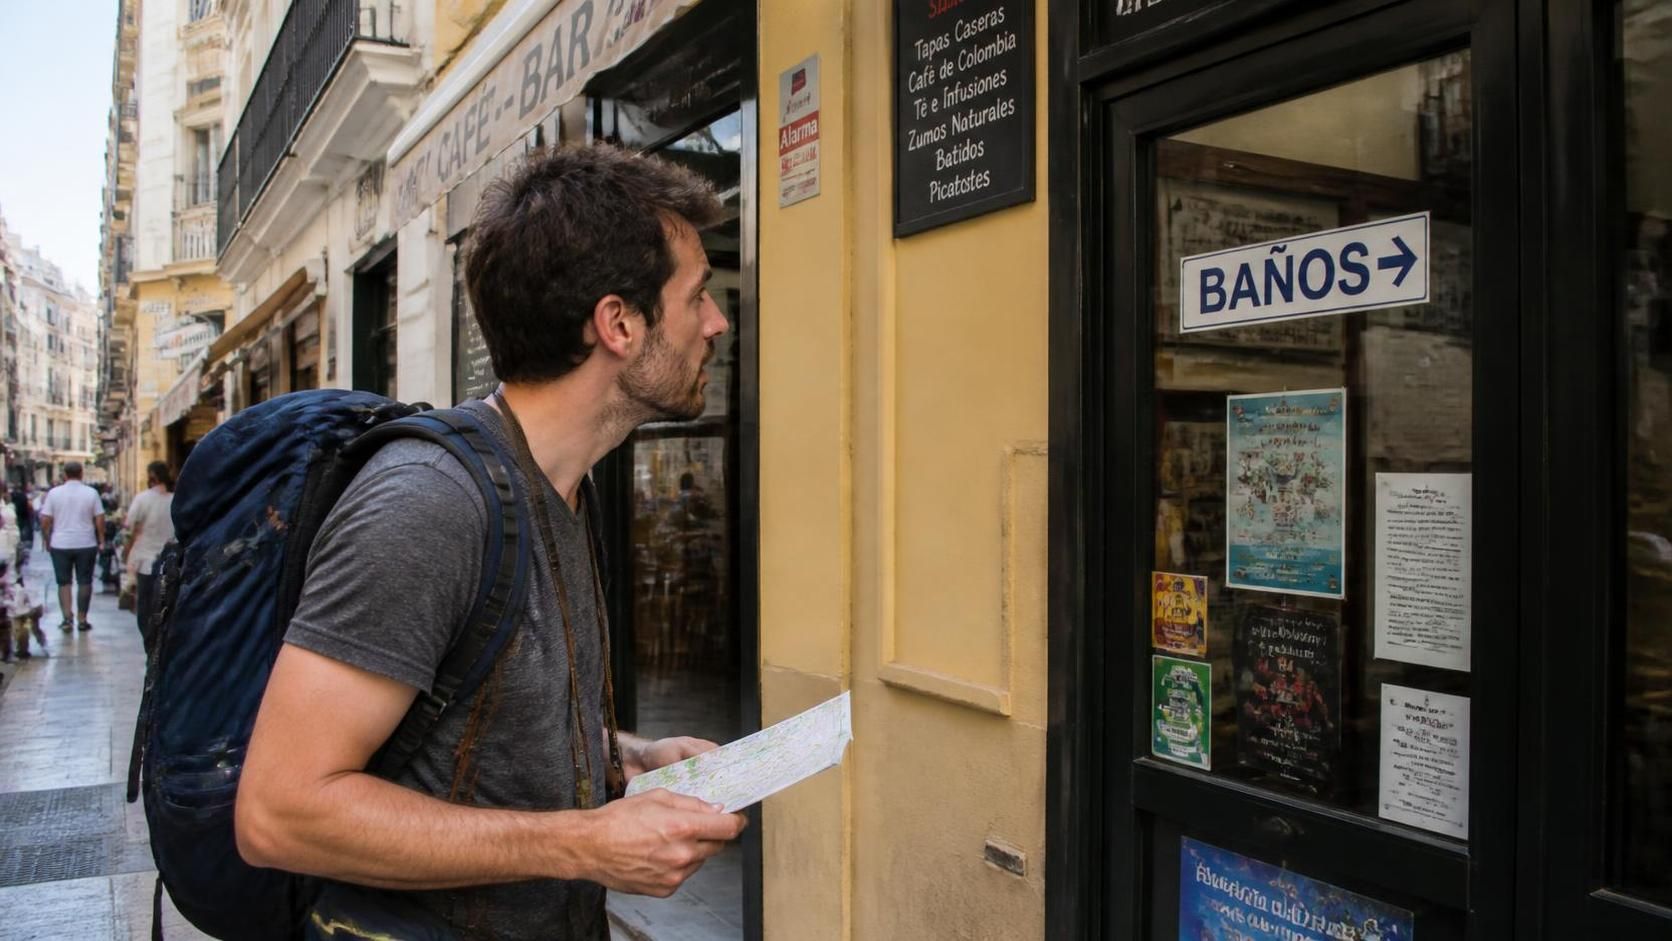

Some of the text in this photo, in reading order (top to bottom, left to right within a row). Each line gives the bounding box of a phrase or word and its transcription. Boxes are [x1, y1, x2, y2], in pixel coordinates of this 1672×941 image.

[914, 32, 950, 61] Tapas
[954, 6, 1005, 42] Caseras
[908, 31, 1016, 93] Café de Colombia
[436, 83, 496, 183] CAFÉ
[518, 0, 595, 120] BAR
[931, 98, 939, 113] e
[943, 69, 1007, 109] Infusiones
[780, 119, 818, 150] Alarma
[908, 98, 1015, 152] Zumos Naturales
[1200, 242, 1370, 314] BAÑOS
